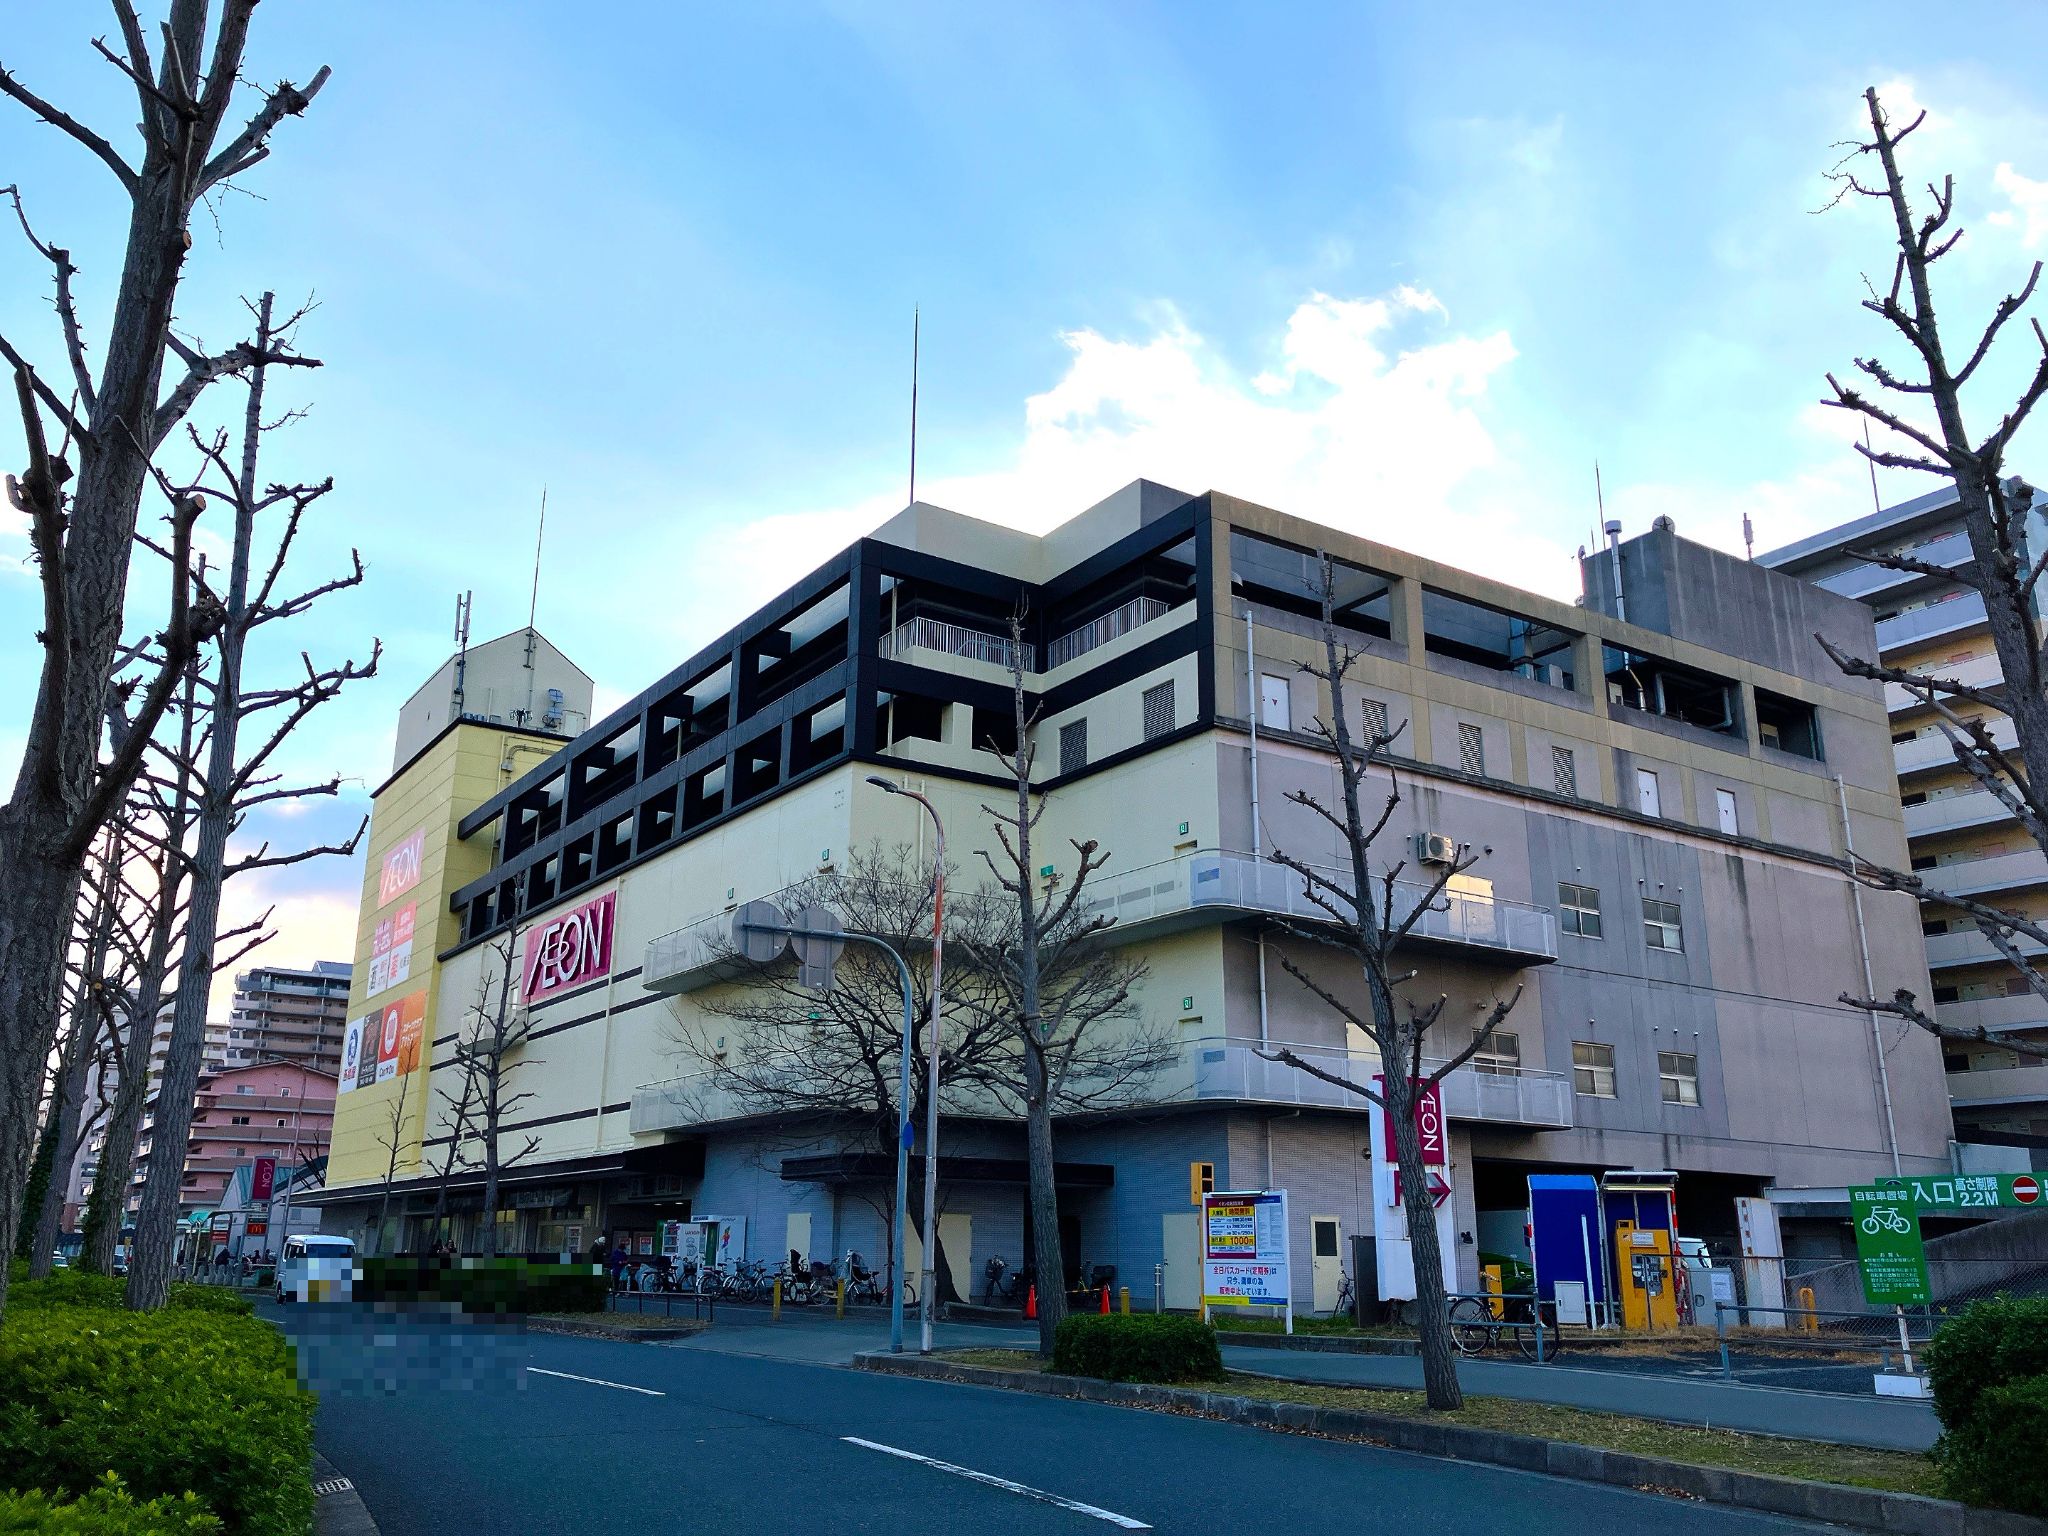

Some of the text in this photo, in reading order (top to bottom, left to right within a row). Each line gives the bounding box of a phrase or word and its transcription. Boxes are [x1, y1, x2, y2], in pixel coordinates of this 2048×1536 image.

[1954, 1177, 1998, 1192] 高さ制限
[1855, 1190, 1908, 1201] 自転車置場
[1911, 1181, 1955, 1204] 入口
[1959, 1191, 1999, 1207] 2.2M
